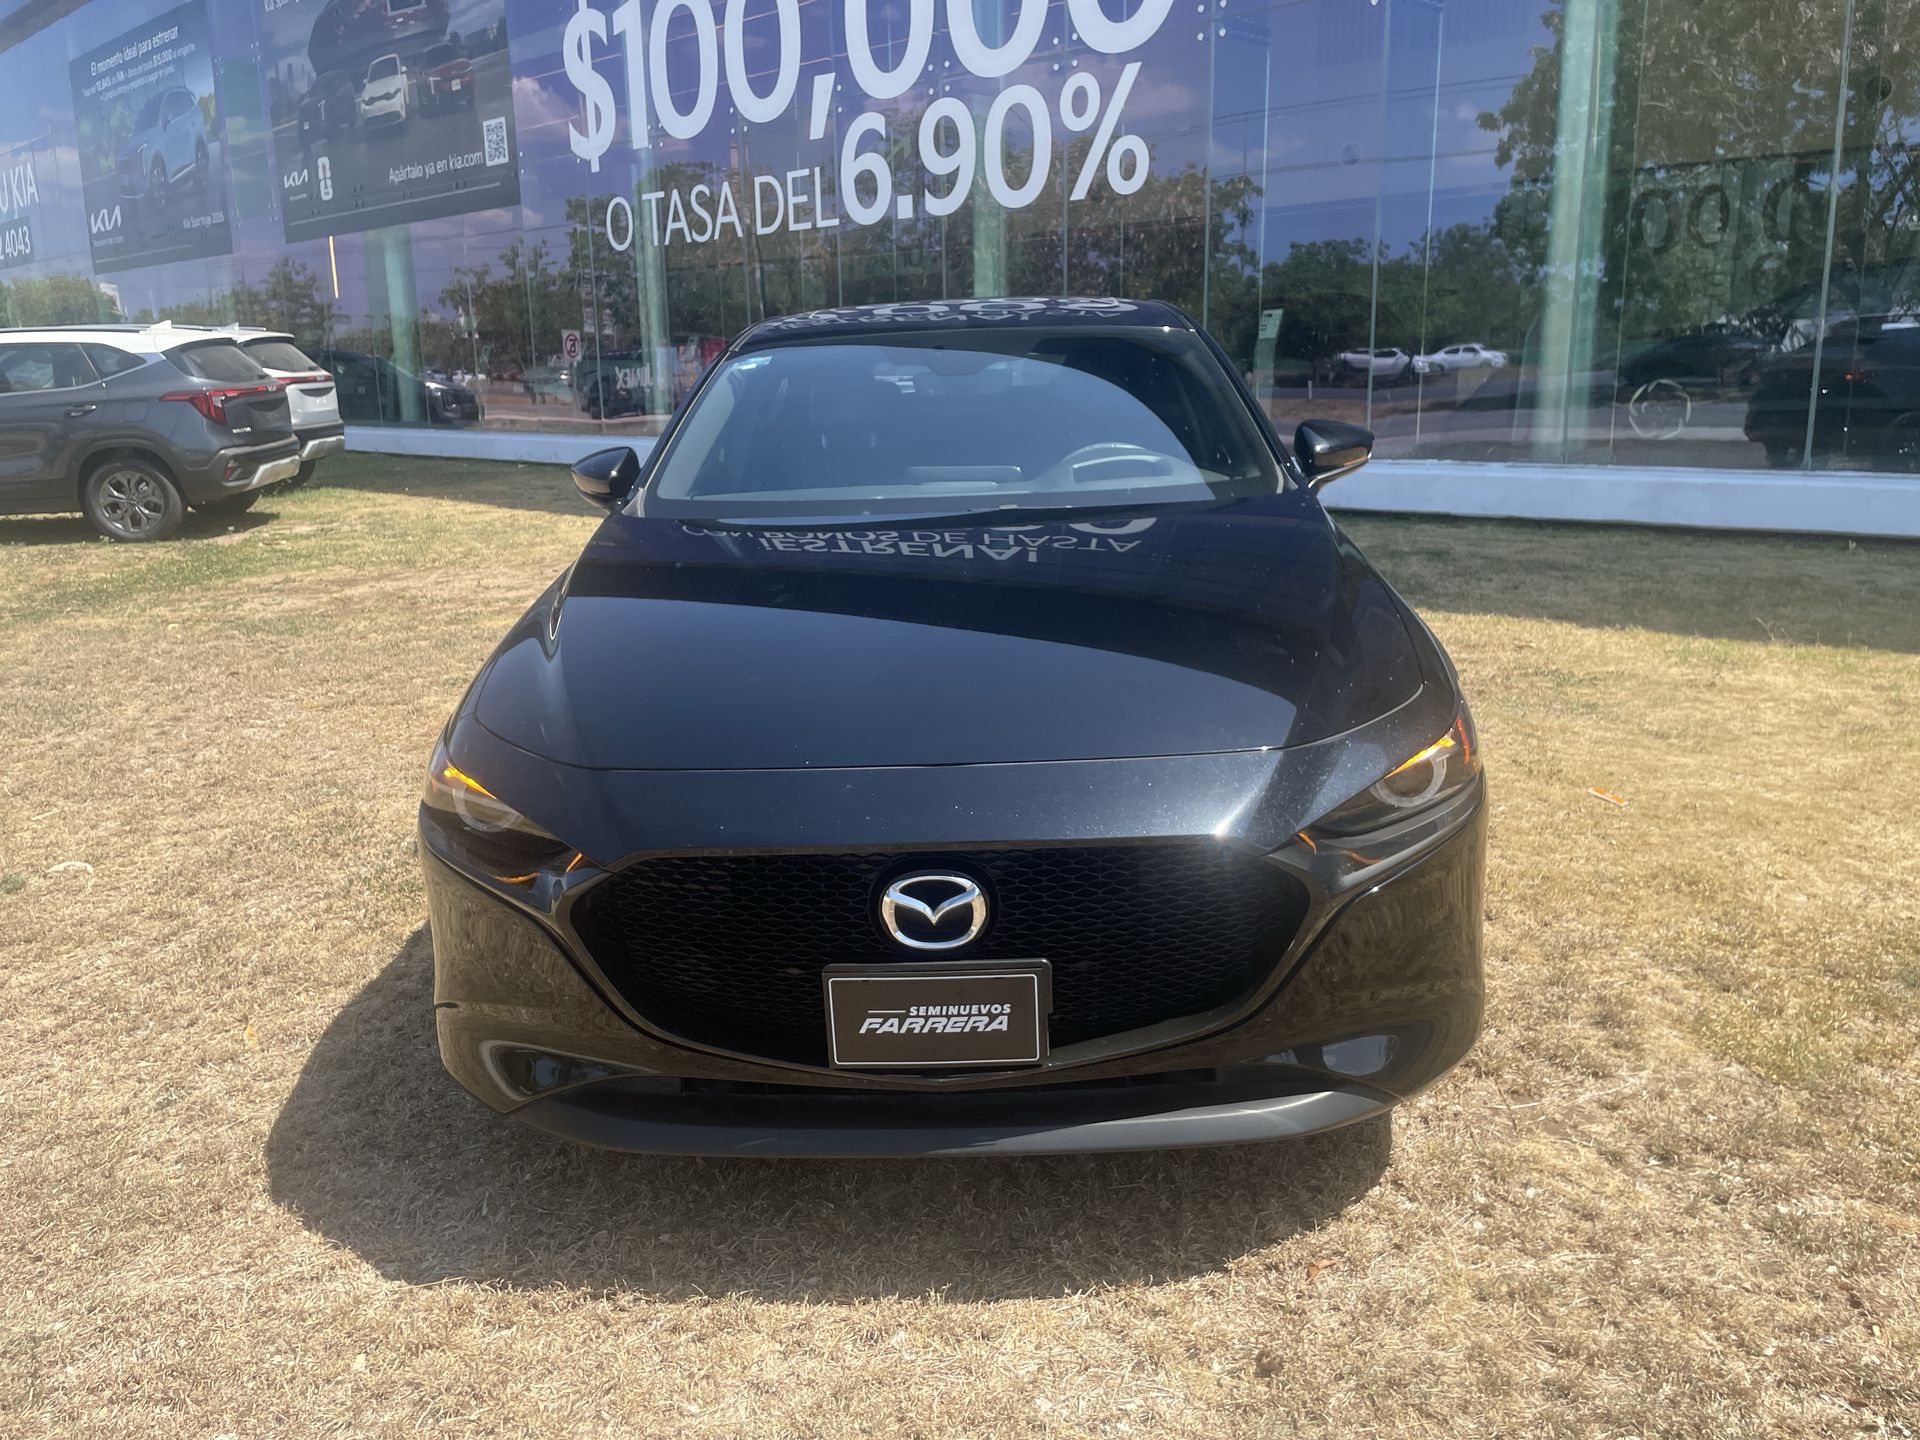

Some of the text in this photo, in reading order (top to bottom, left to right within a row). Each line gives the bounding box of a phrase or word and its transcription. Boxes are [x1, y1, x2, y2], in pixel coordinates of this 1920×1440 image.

[90, 26, 179, 76] El momento ideal para estrenar
[389, 151, 484, 186] Apártalo ya en kia.com
[606, 61, 1150, 251] O TASA DEL 6.90%
[91, 205, 121, 233] KIA
[5, 225, 31, 258] 4043
[858, 1015, 1009, 1034] FARRERA
[909, 1003, 1011, 1016] SEMINUEVOS
